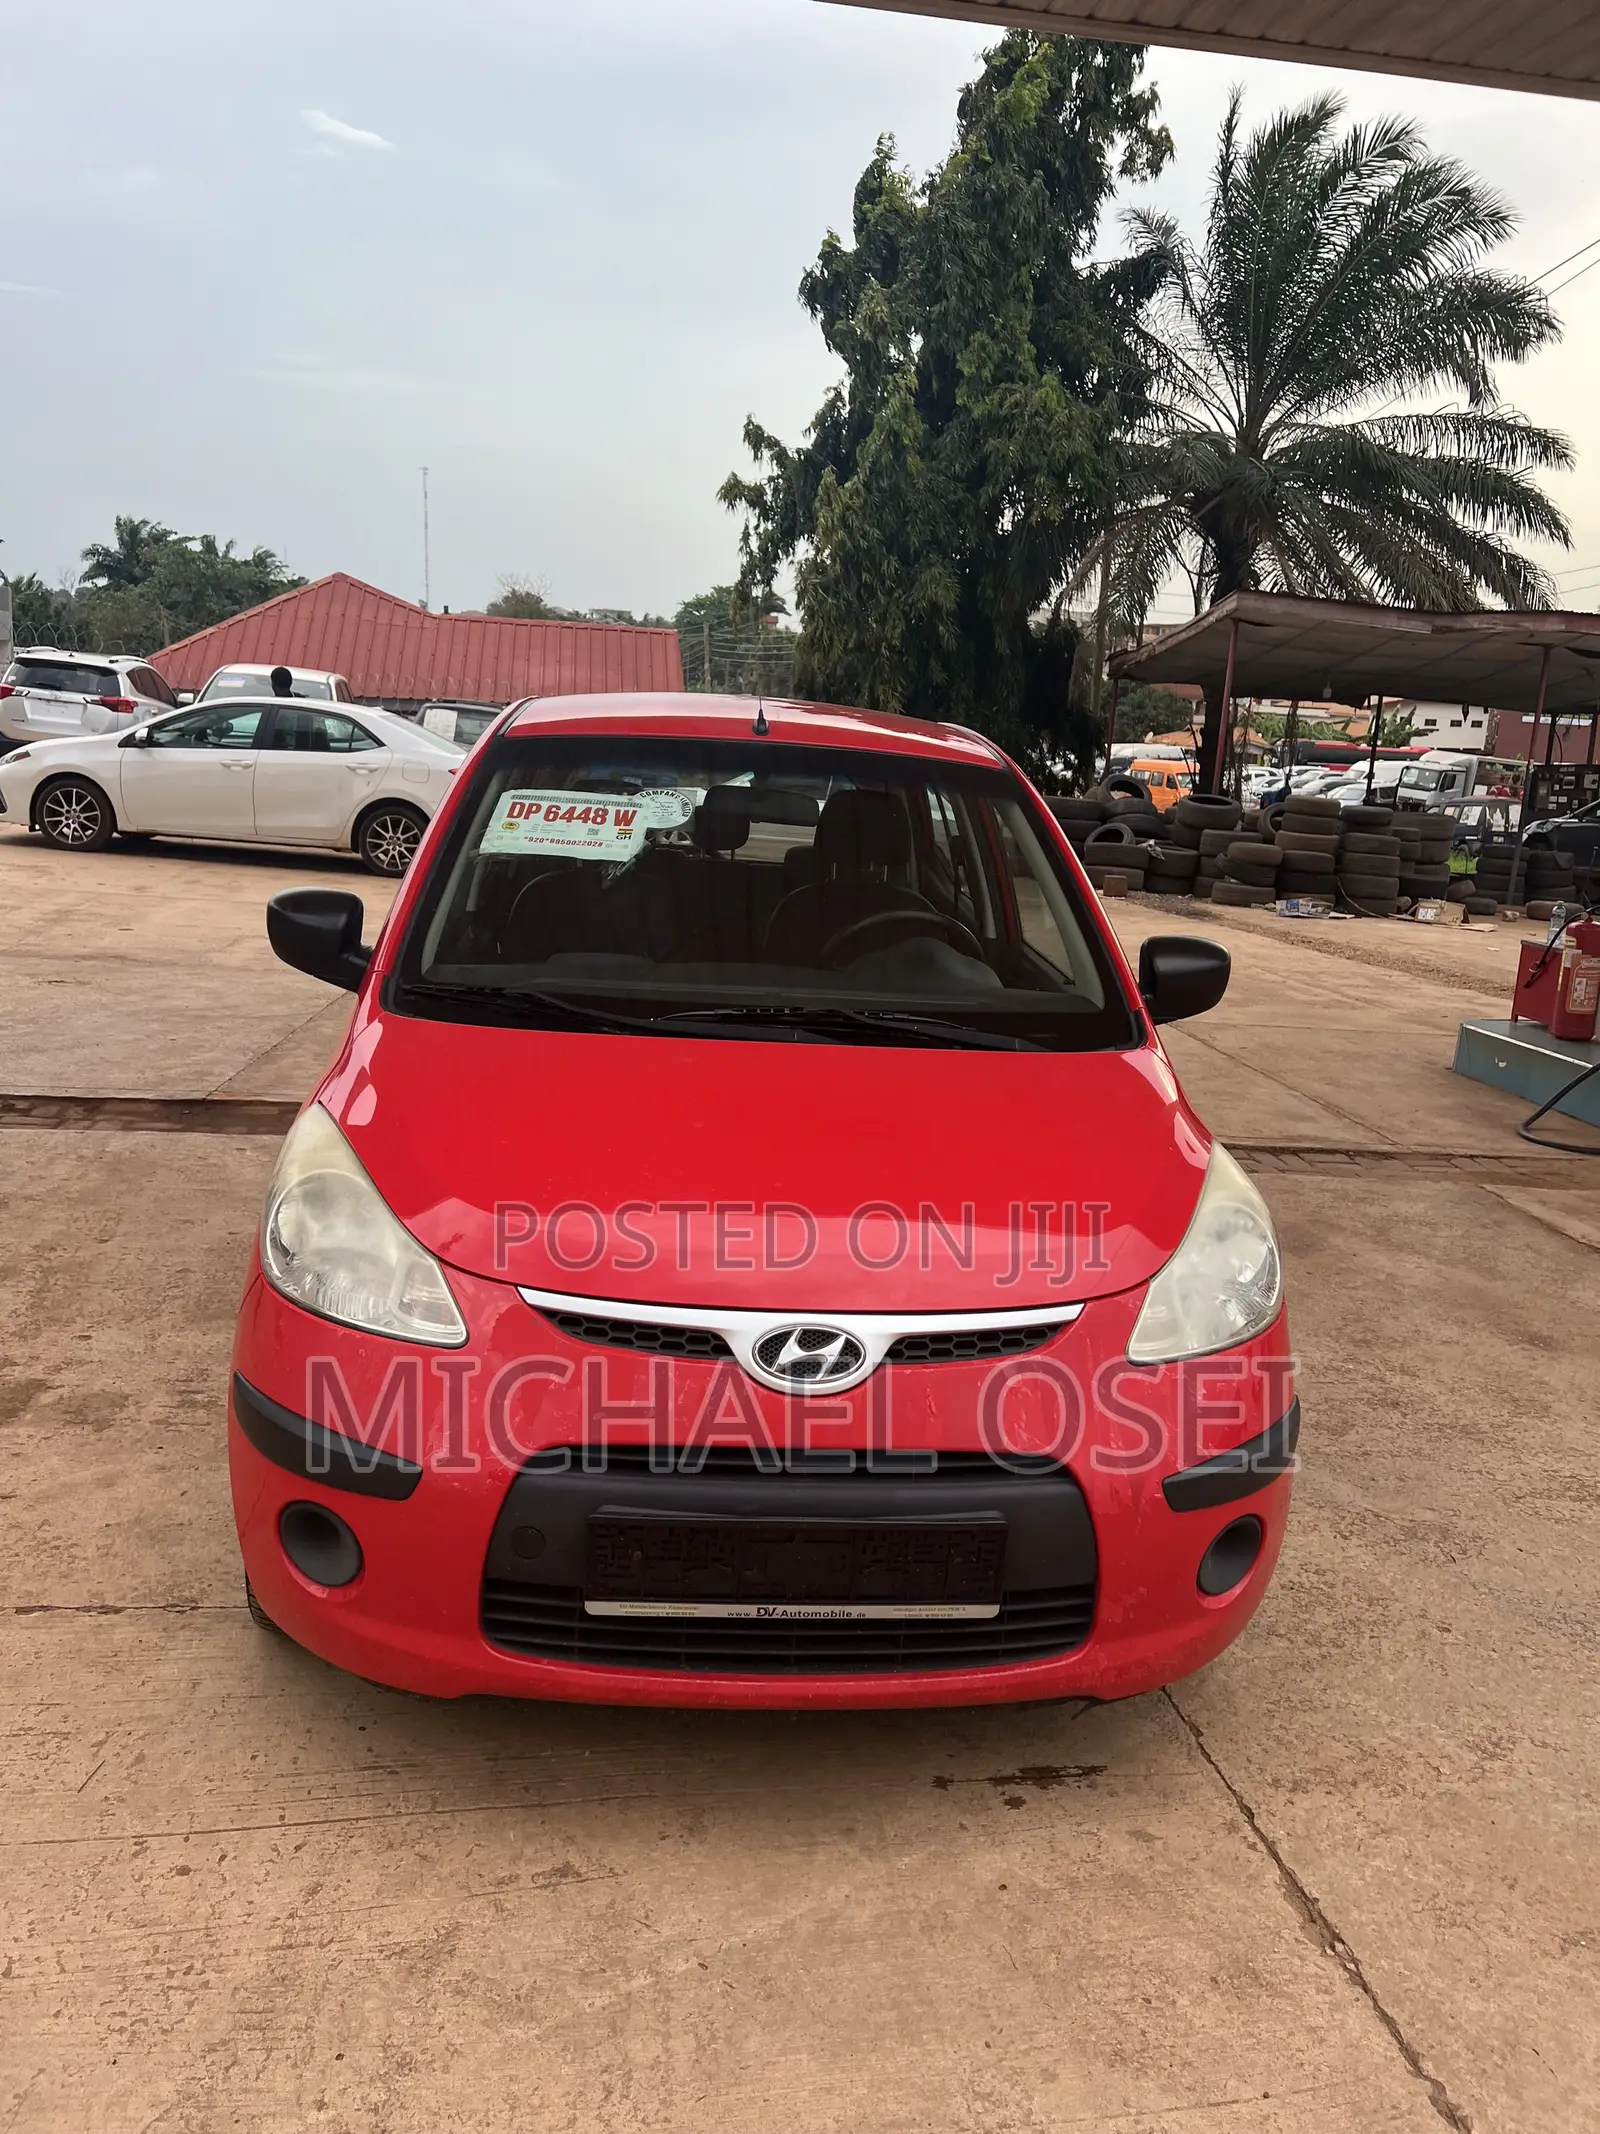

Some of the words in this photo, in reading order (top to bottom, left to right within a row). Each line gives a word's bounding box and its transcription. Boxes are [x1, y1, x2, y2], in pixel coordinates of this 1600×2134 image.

[506, 801, 542, 821] DP
[543, 804, 610, 826] 6448
[613, 809, 638, 827] W
